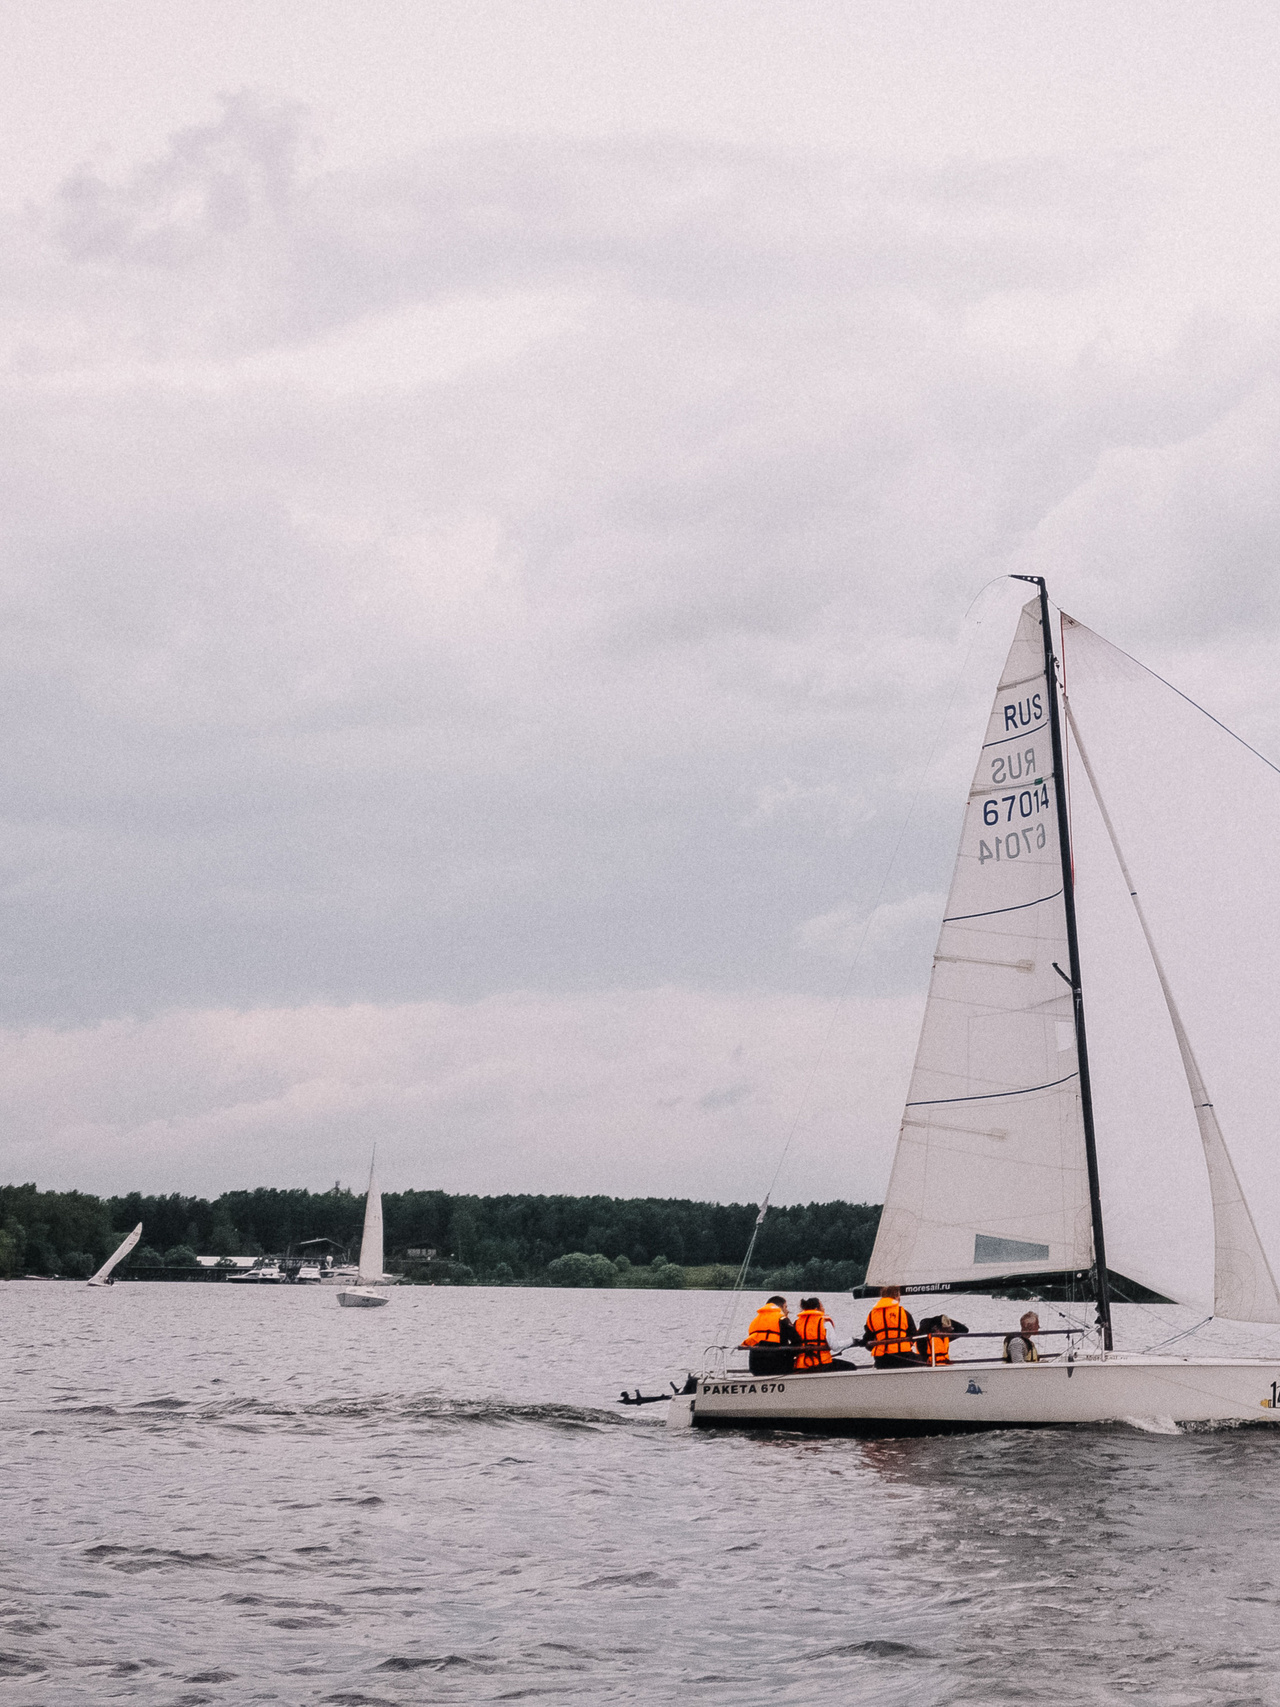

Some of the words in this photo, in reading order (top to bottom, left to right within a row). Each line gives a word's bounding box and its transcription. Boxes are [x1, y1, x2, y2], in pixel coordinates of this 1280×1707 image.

[1003, 693, 1043, 731] RUS
[983, 783, 1050, 826] 67014
[905, 1283, 951, 1293] moresail.ru
[761, 1383, 785, 1393] 670
